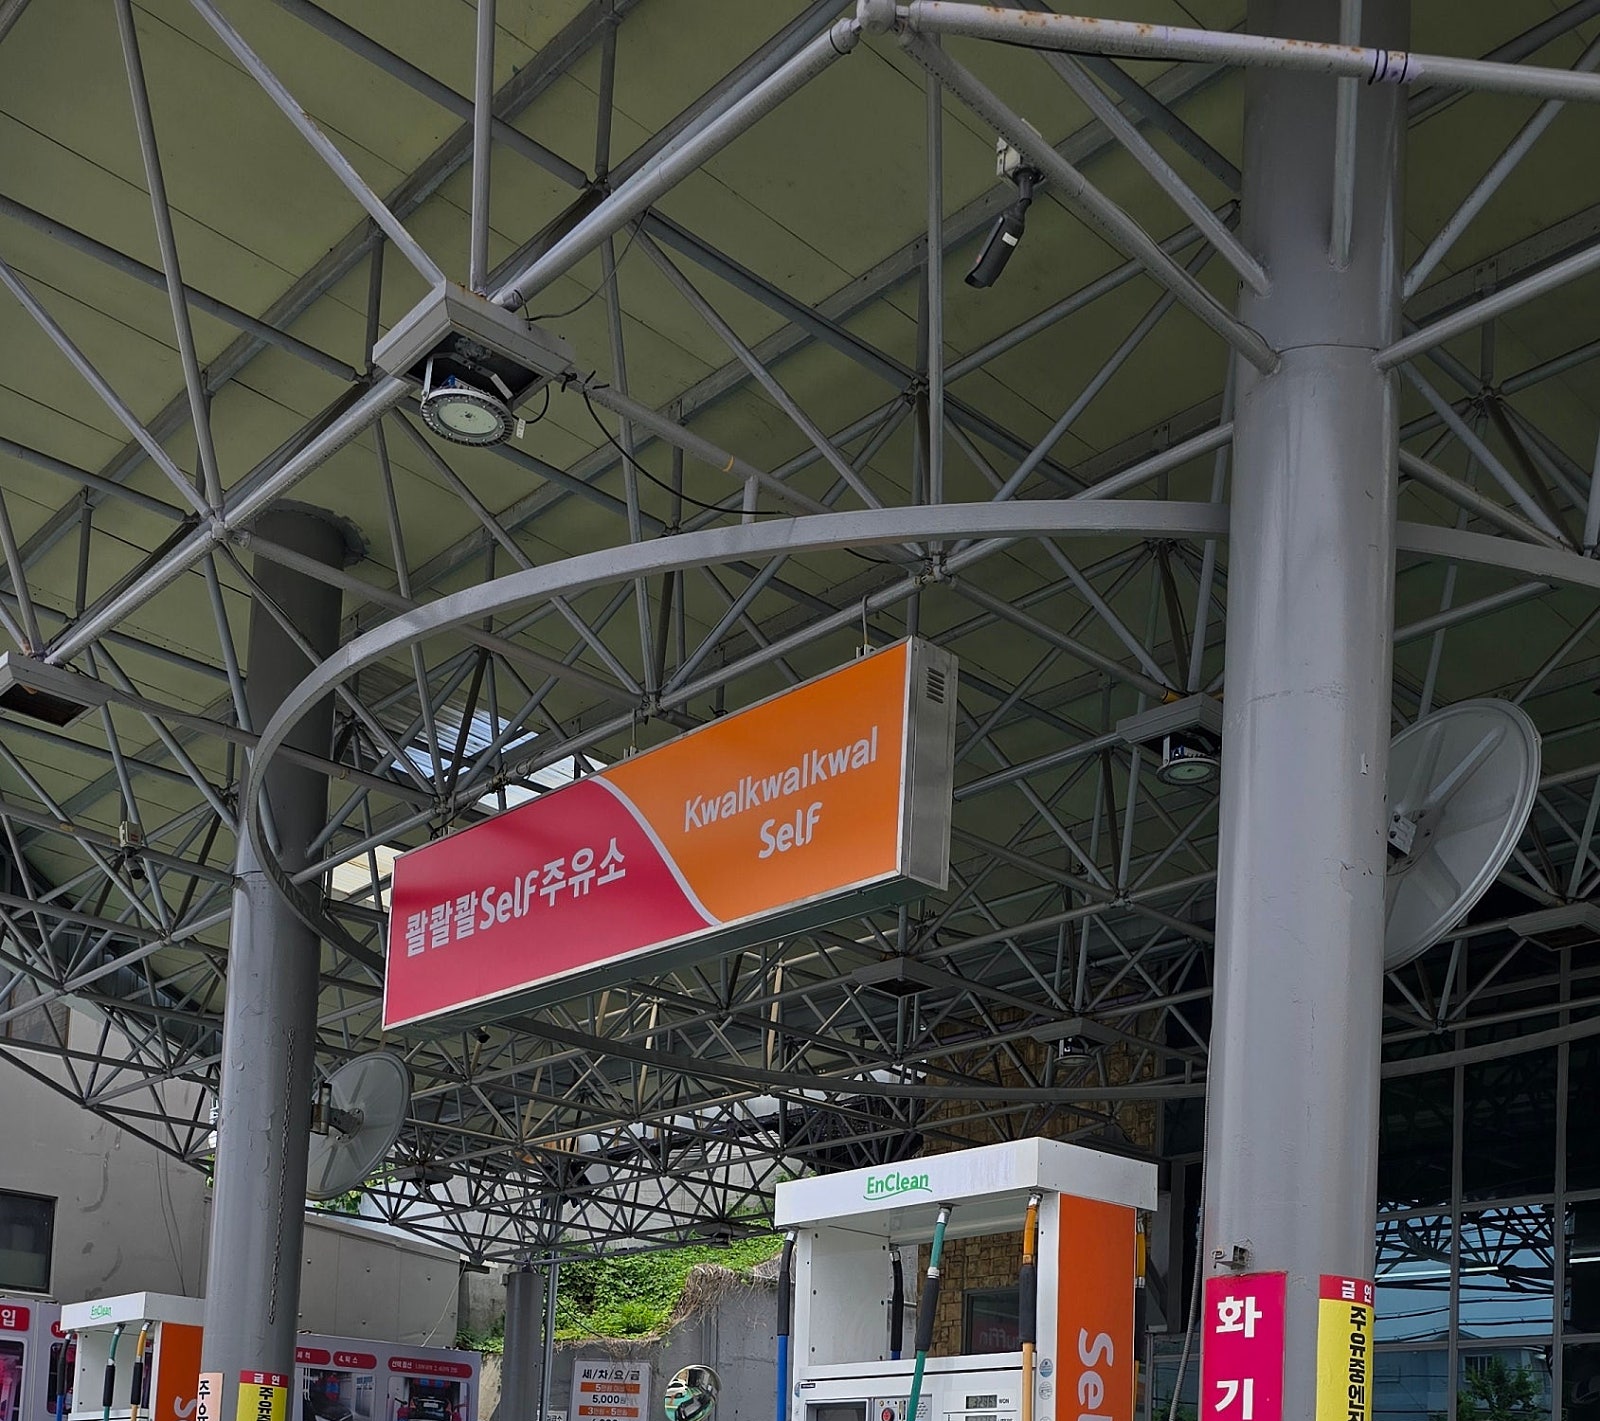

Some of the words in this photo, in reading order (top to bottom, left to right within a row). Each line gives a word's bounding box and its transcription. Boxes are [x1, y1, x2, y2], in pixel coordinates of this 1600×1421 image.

[683, 726, 878, 833] Kwalkwalkwal
[757, 801, 823, 861] Self
[867, 1171, 929, 1195] EnClean
